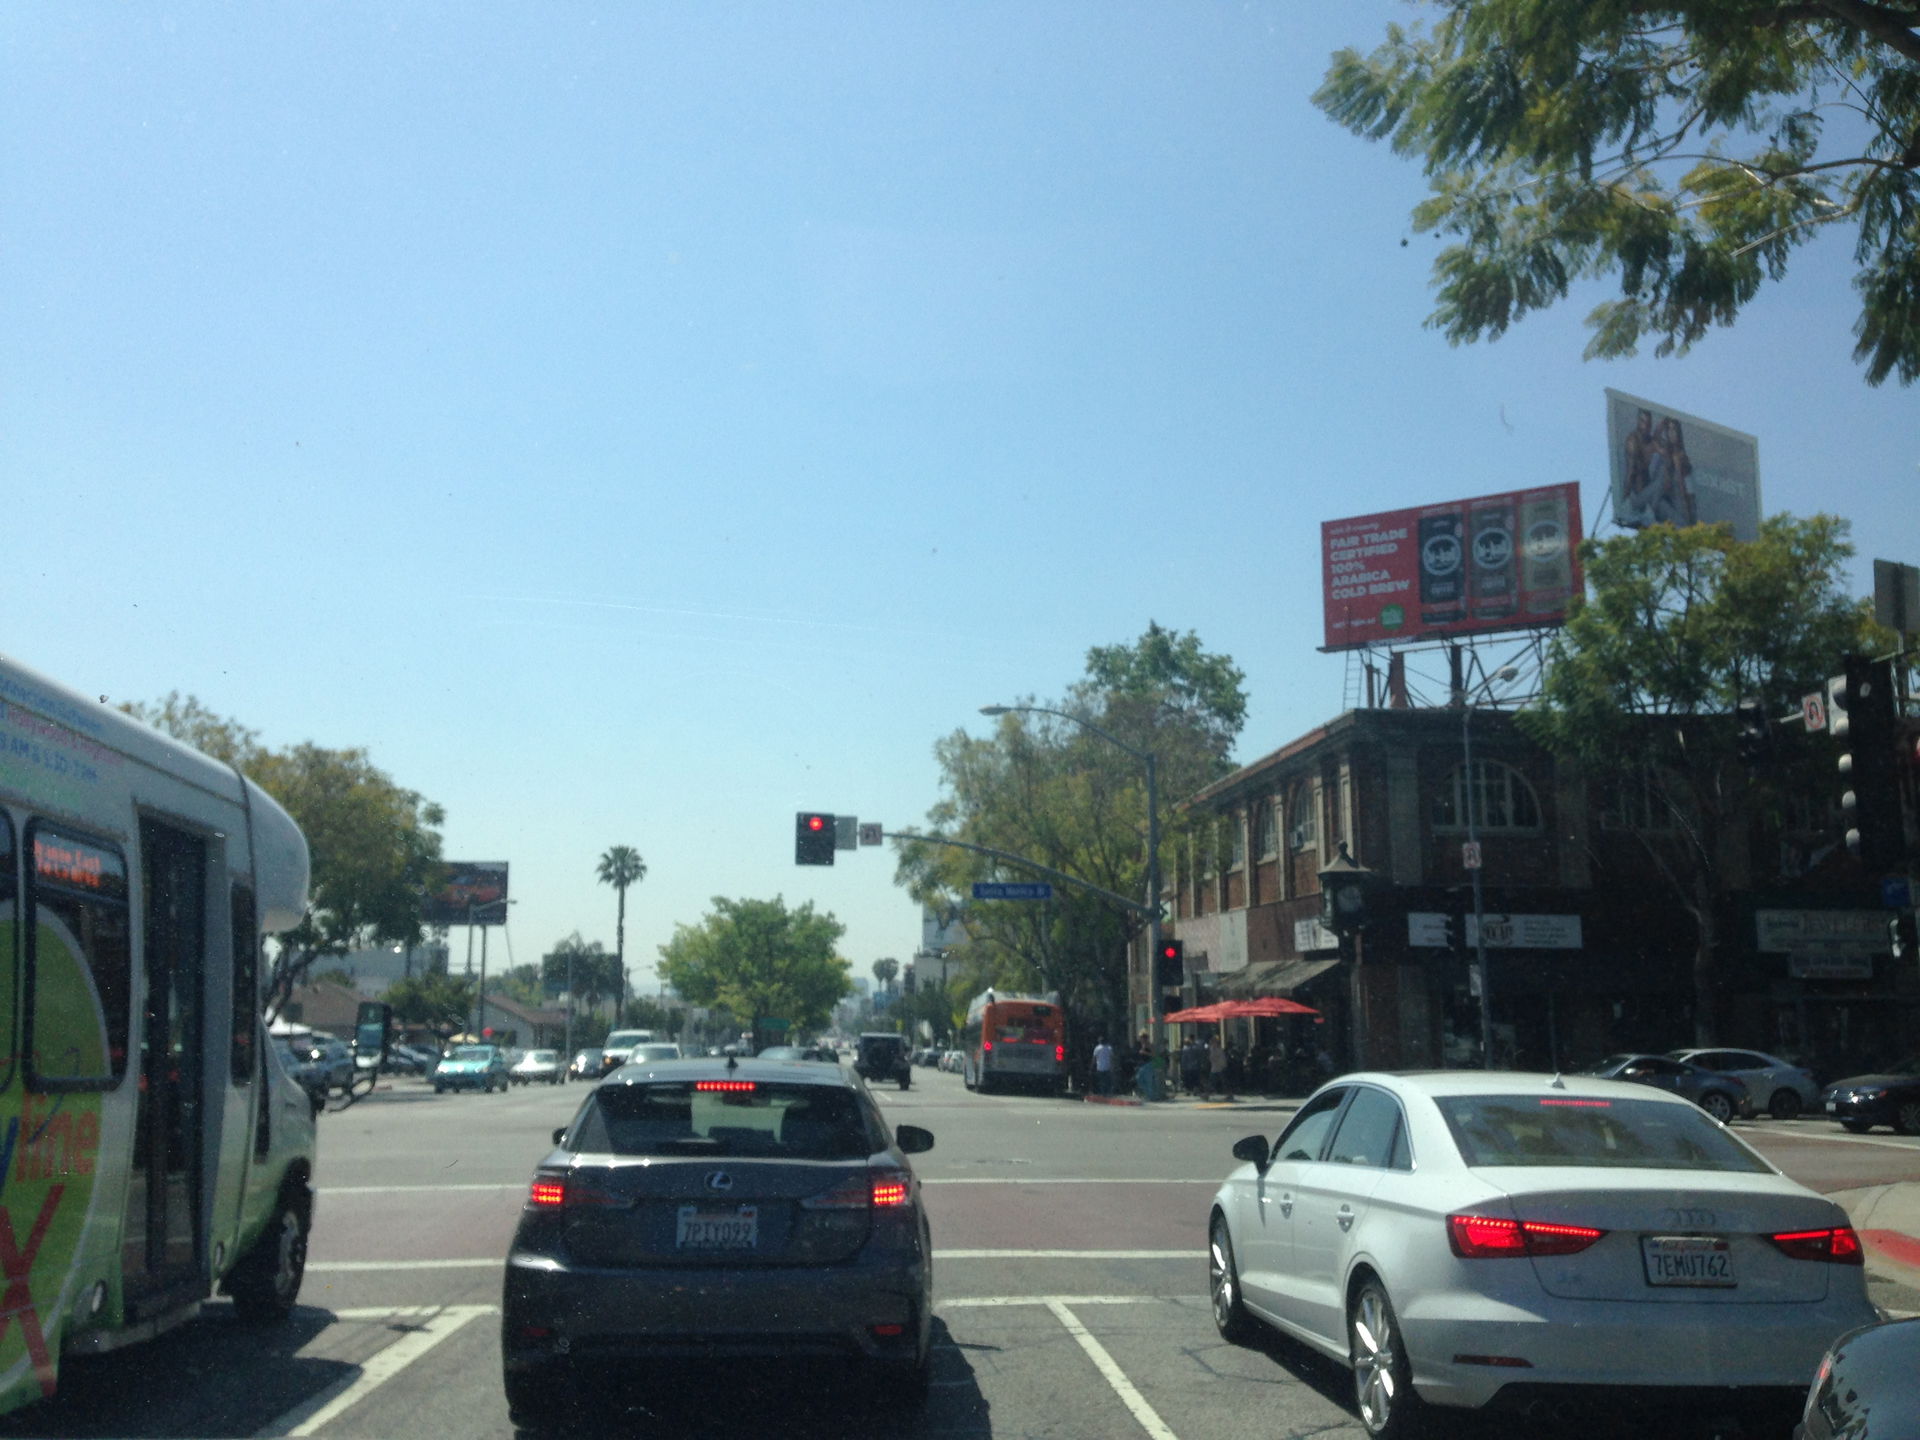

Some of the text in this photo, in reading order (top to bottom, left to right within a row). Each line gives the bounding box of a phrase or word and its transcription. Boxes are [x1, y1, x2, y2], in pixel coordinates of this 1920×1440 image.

[1330, 535, 1361, 550] FAIR
[1362, 528, 1408, 545] TRADE
[1330, 542, 1399, 562] CERTIFIED
[1331, 569, 1392, 587] ARABICA
[1332, 579, 1410, 601] COLD BREW
[1652, 1255, 1730, 1278] 7EMU762
